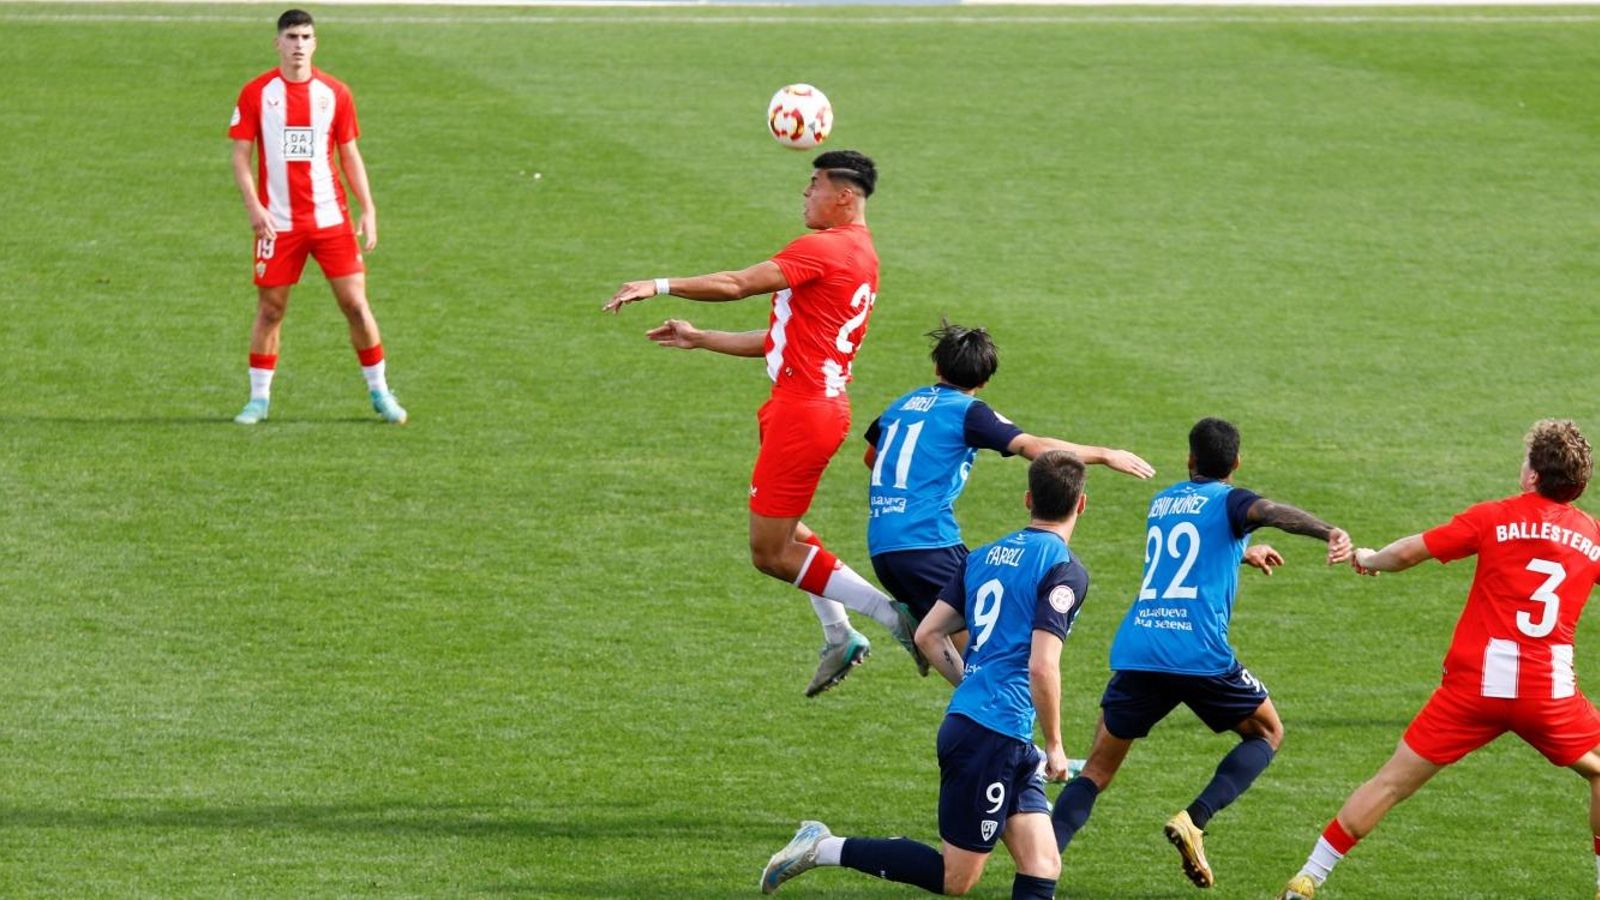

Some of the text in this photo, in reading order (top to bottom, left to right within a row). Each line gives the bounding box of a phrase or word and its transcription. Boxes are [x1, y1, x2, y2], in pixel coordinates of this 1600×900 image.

[836, 283, 876, 353] 2
[871, 418, 925, 489] 11
[1139, 521, 1200, 602] 22
[1516, 557, 1567, 638] 3
[970, 578, 1004, 652] 9
[986, 781, 1005, 814] 9
